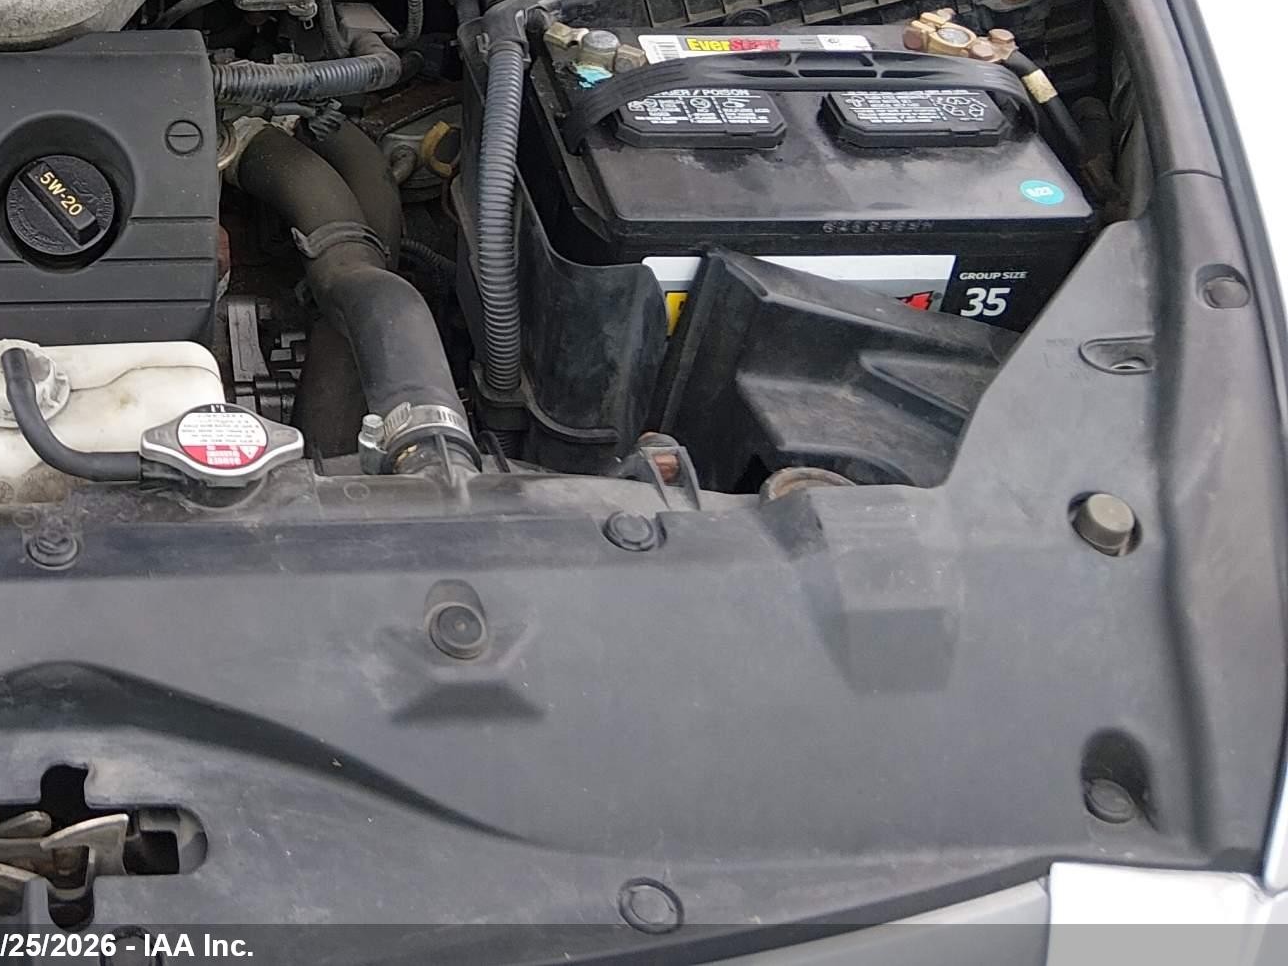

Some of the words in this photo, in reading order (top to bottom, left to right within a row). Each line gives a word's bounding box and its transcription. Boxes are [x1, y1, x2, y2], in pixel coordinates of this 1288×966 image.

[40, 171, 83, 216] 5W-20
[959, 271, 1001, 280] GROUP
[1002, 271, 1027, 279] SIZE
[960, 287, 1011, 317] 35
